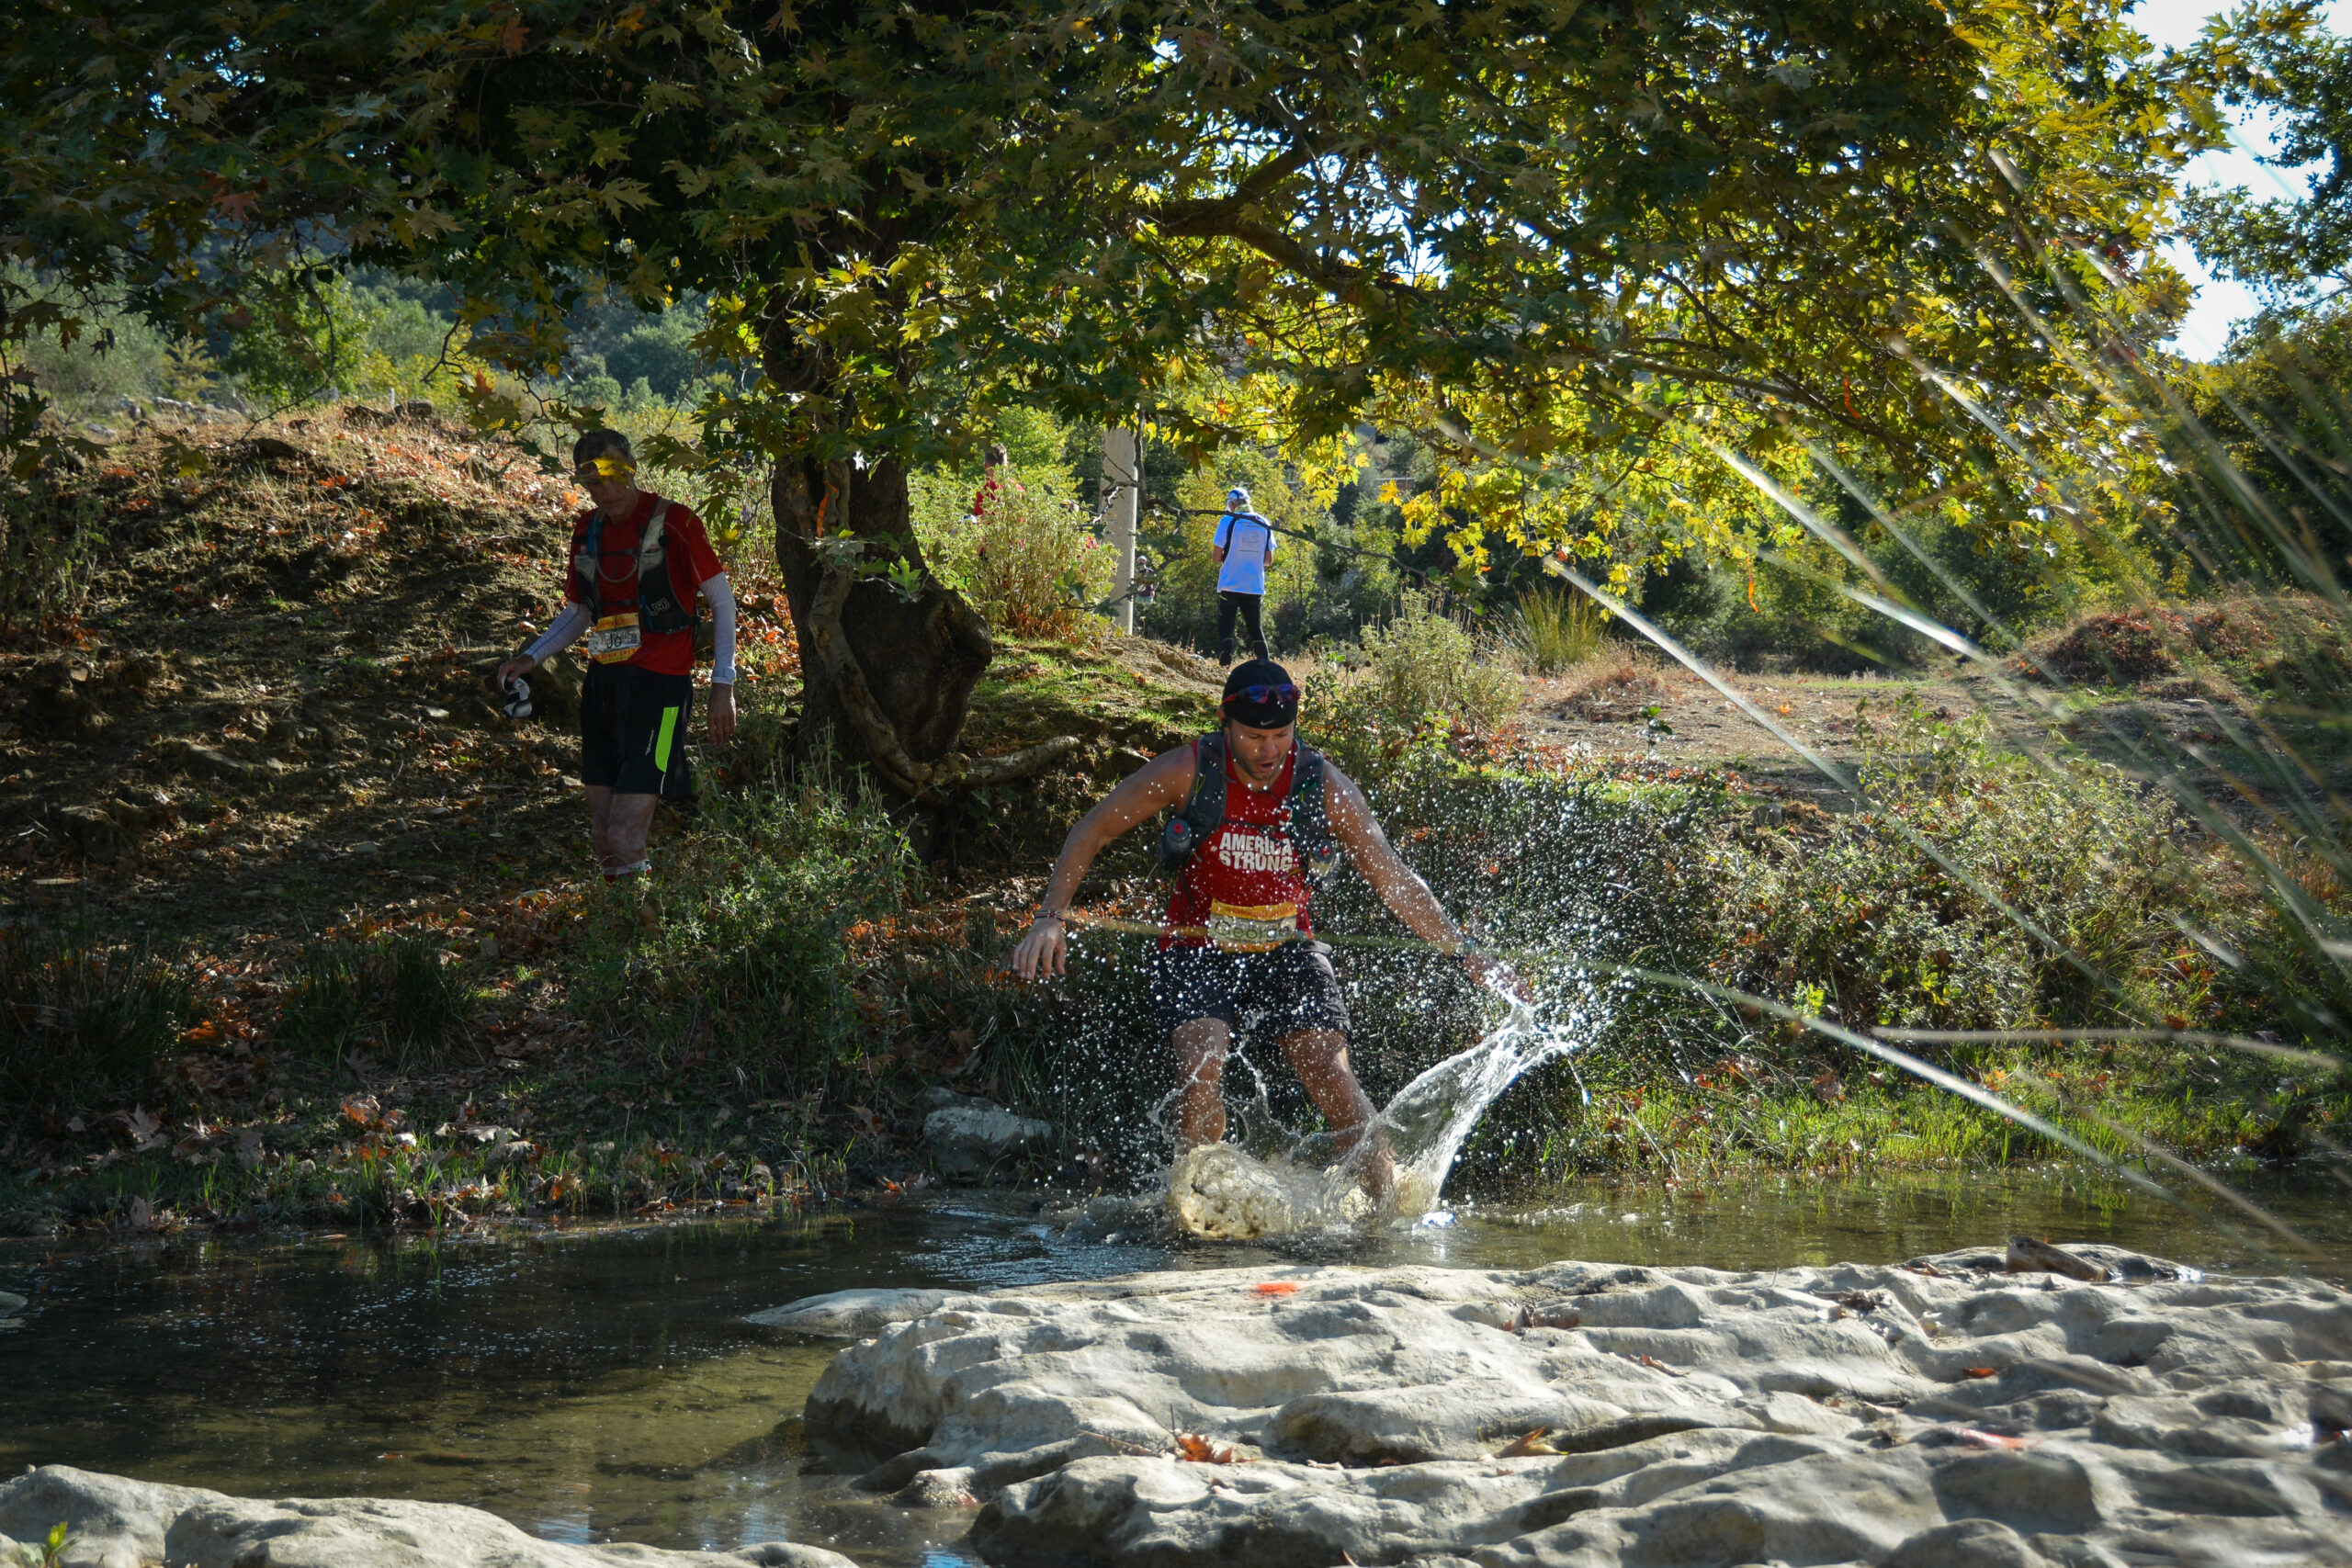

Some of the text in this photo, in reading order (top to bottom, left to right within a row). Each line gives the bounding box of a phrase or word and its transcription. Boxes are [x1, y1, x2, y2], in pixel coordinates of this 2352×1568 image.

[1219, 832, 1293, 856] AMERICA
[1219, 851, 1294, 872] STRONG
[1215, 919, 1291, 942] George
